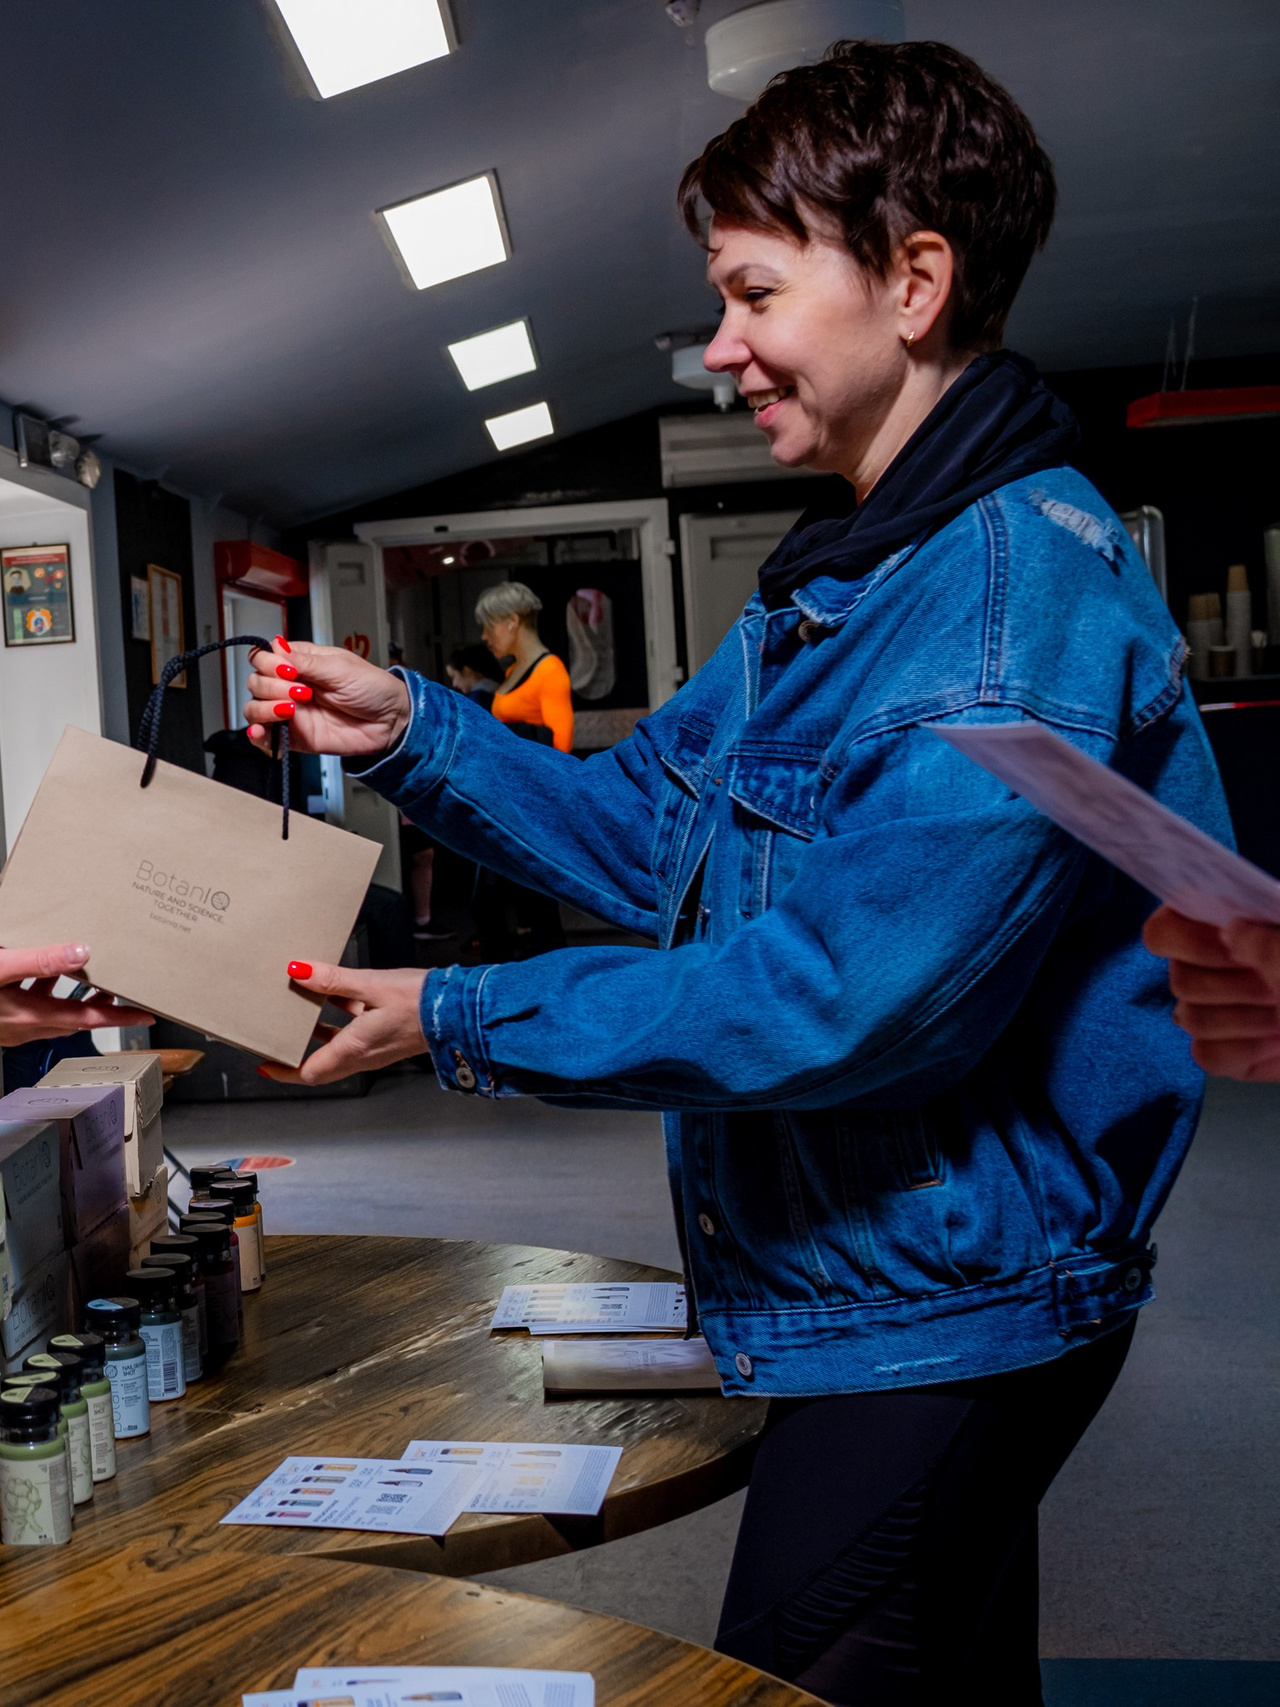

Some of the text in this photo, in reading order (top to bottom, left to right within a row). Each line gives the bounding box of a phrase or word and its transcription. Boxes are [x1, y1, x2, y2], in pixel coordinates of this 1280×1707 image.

[132, 881, 167, 901] NATURE
[167, 895, 187, 909] AND
[136, 859, 231, 912] BotanIQ
[153, 899, 199, 922] TOGETHER
